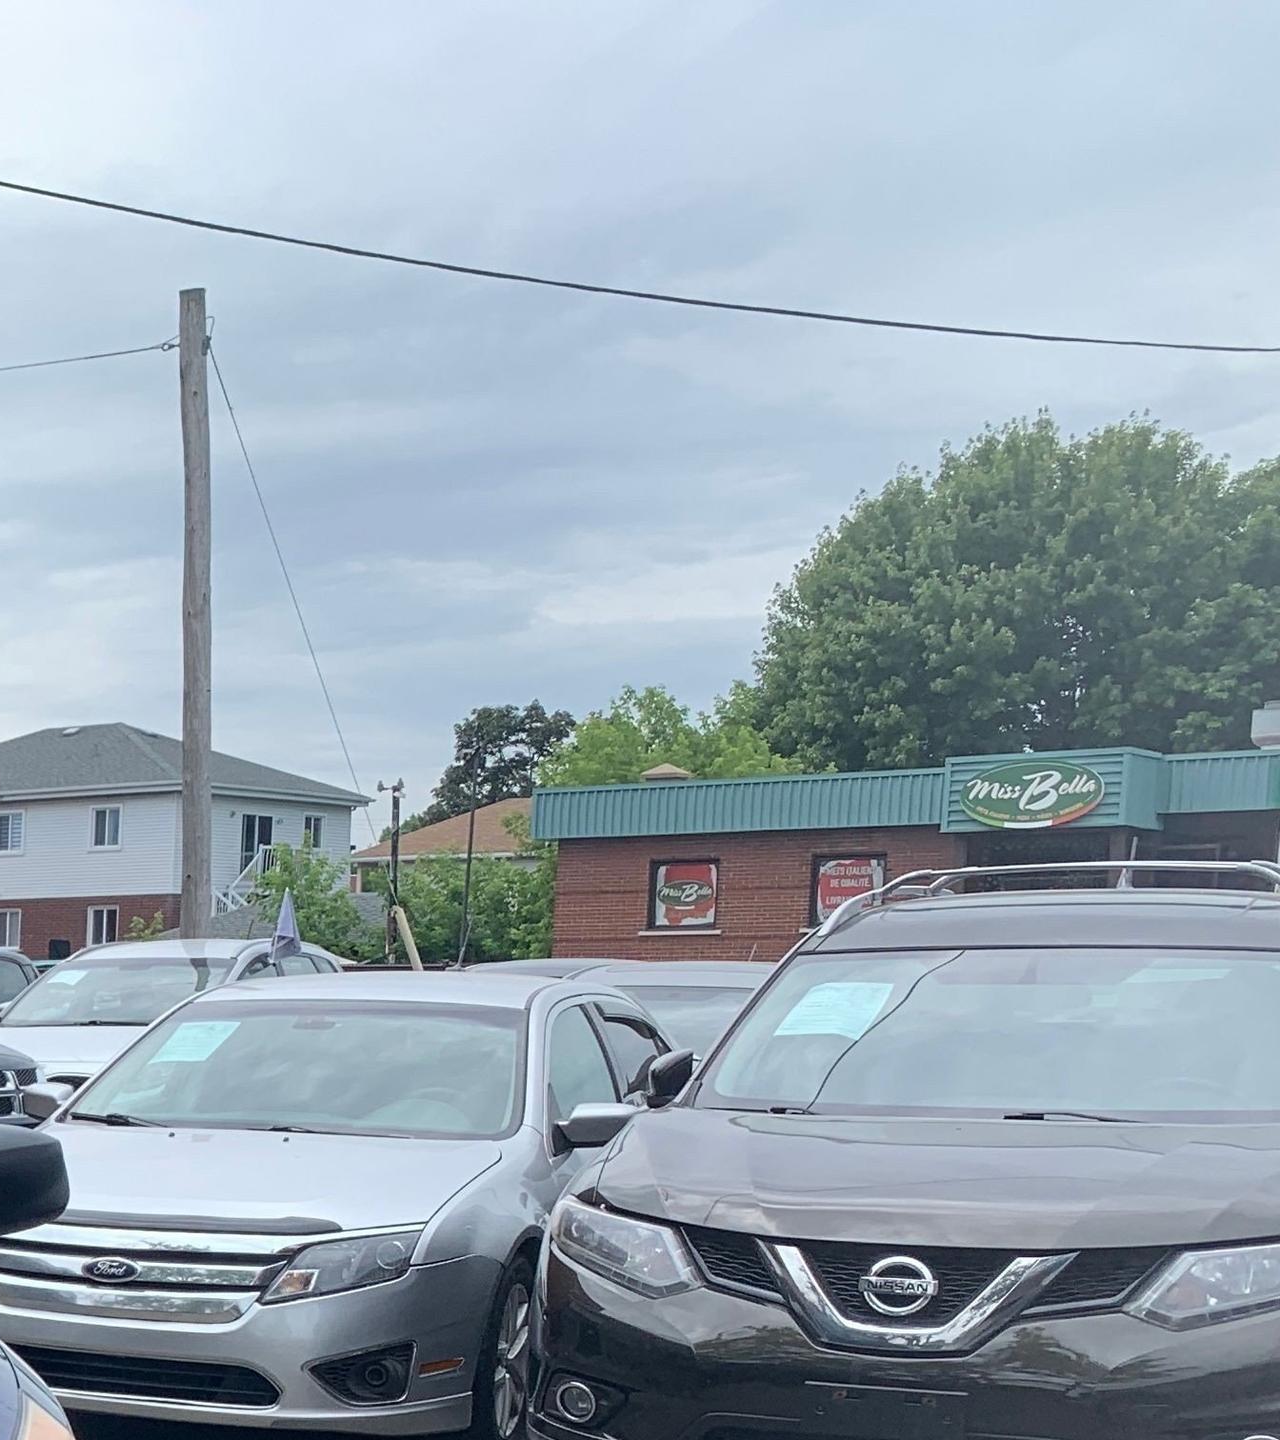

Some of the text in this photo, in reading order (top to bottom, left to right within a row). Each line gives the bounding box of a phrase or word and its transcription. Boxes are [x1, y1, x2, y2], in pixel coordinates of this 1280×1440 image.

[966, 779, 1023, 800] Miss
[1018, 770, 1097, 811] Bella
[93, 1260, 127, 1276] Ford
[867, 1281, 928, 1292] NISSAN
